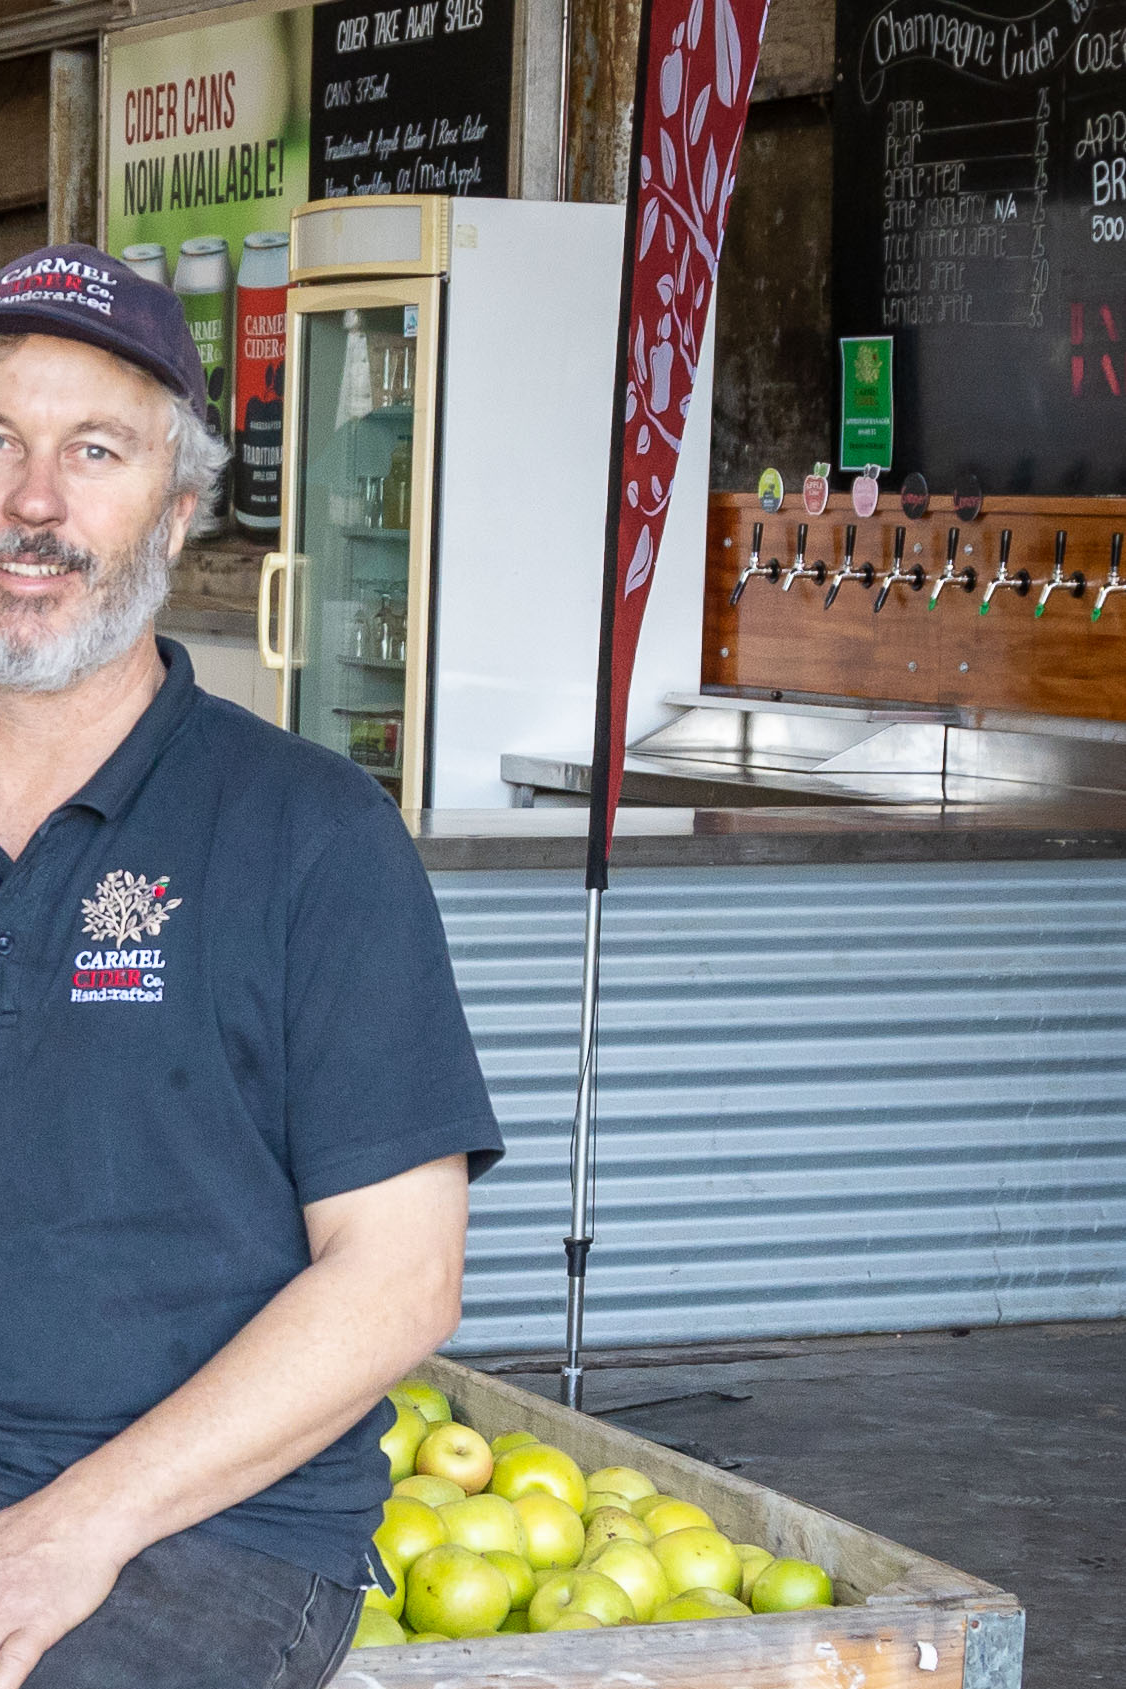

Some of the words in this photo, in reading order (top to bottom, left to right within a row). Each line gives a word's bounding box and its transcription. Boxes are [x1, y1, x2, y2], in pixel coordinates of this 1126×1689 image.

[337, 15, 369, 53] CIDER
[373, 9, 402, 45] TAKE
[405, 2, 439, 40] AWAY
[444, 0, 483, 33] SALES
[874, 10, 995, 69] Champagne
[1001, 20, 1058, 79] Cider
[1075, 29, 1126, 75] CIDE
[125, 82, 178, 145] CIDER
[184, 70, 236, 135] CANS
[324, 82, 351, 109] CANS
[325, 129, 374, 161] Traditional
[124, 156, 165, 216] NOW
[170, 138, 285, 210] AVAILABLE!
[994, 193, 1017, 223] N/A
[1, 257, 117, 286] CARMEL
[244, 338, 279, 360] CIDER
[75, 949, 166, 970] CARMEL
[72, 969, 142, 988] CIDER
[70, 987, 164, 1003] Handcrafted
